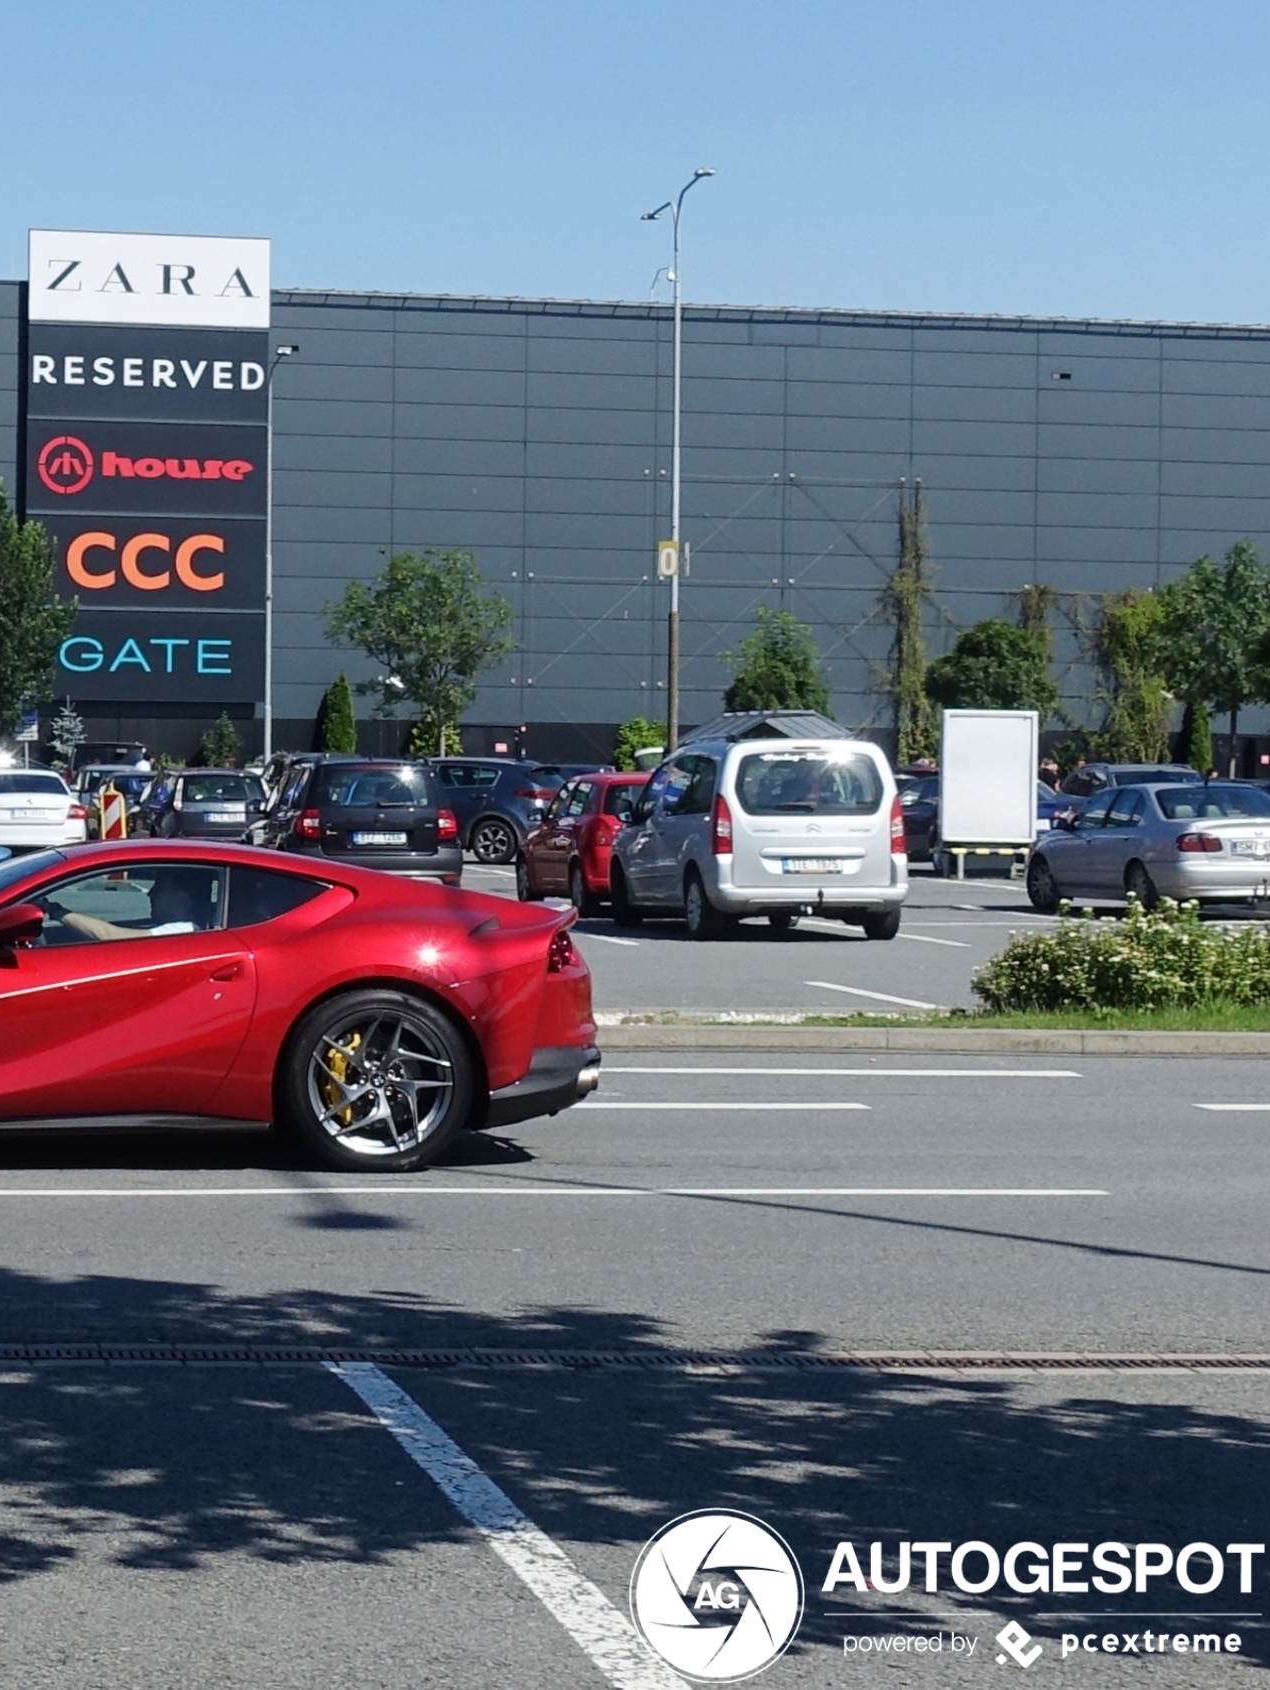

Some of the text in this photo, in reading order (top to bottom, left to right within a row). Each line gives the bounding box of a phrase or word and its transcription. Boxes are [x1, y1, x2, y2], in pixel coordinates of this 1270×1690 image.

[46, 259, 261, 299] ZARA
[32, 354, 266, 391] RESERVED
[101, 451, 254, 481] house
[66, 531, 225, 591] CCC
[59, 636, 233, 674] GATE
